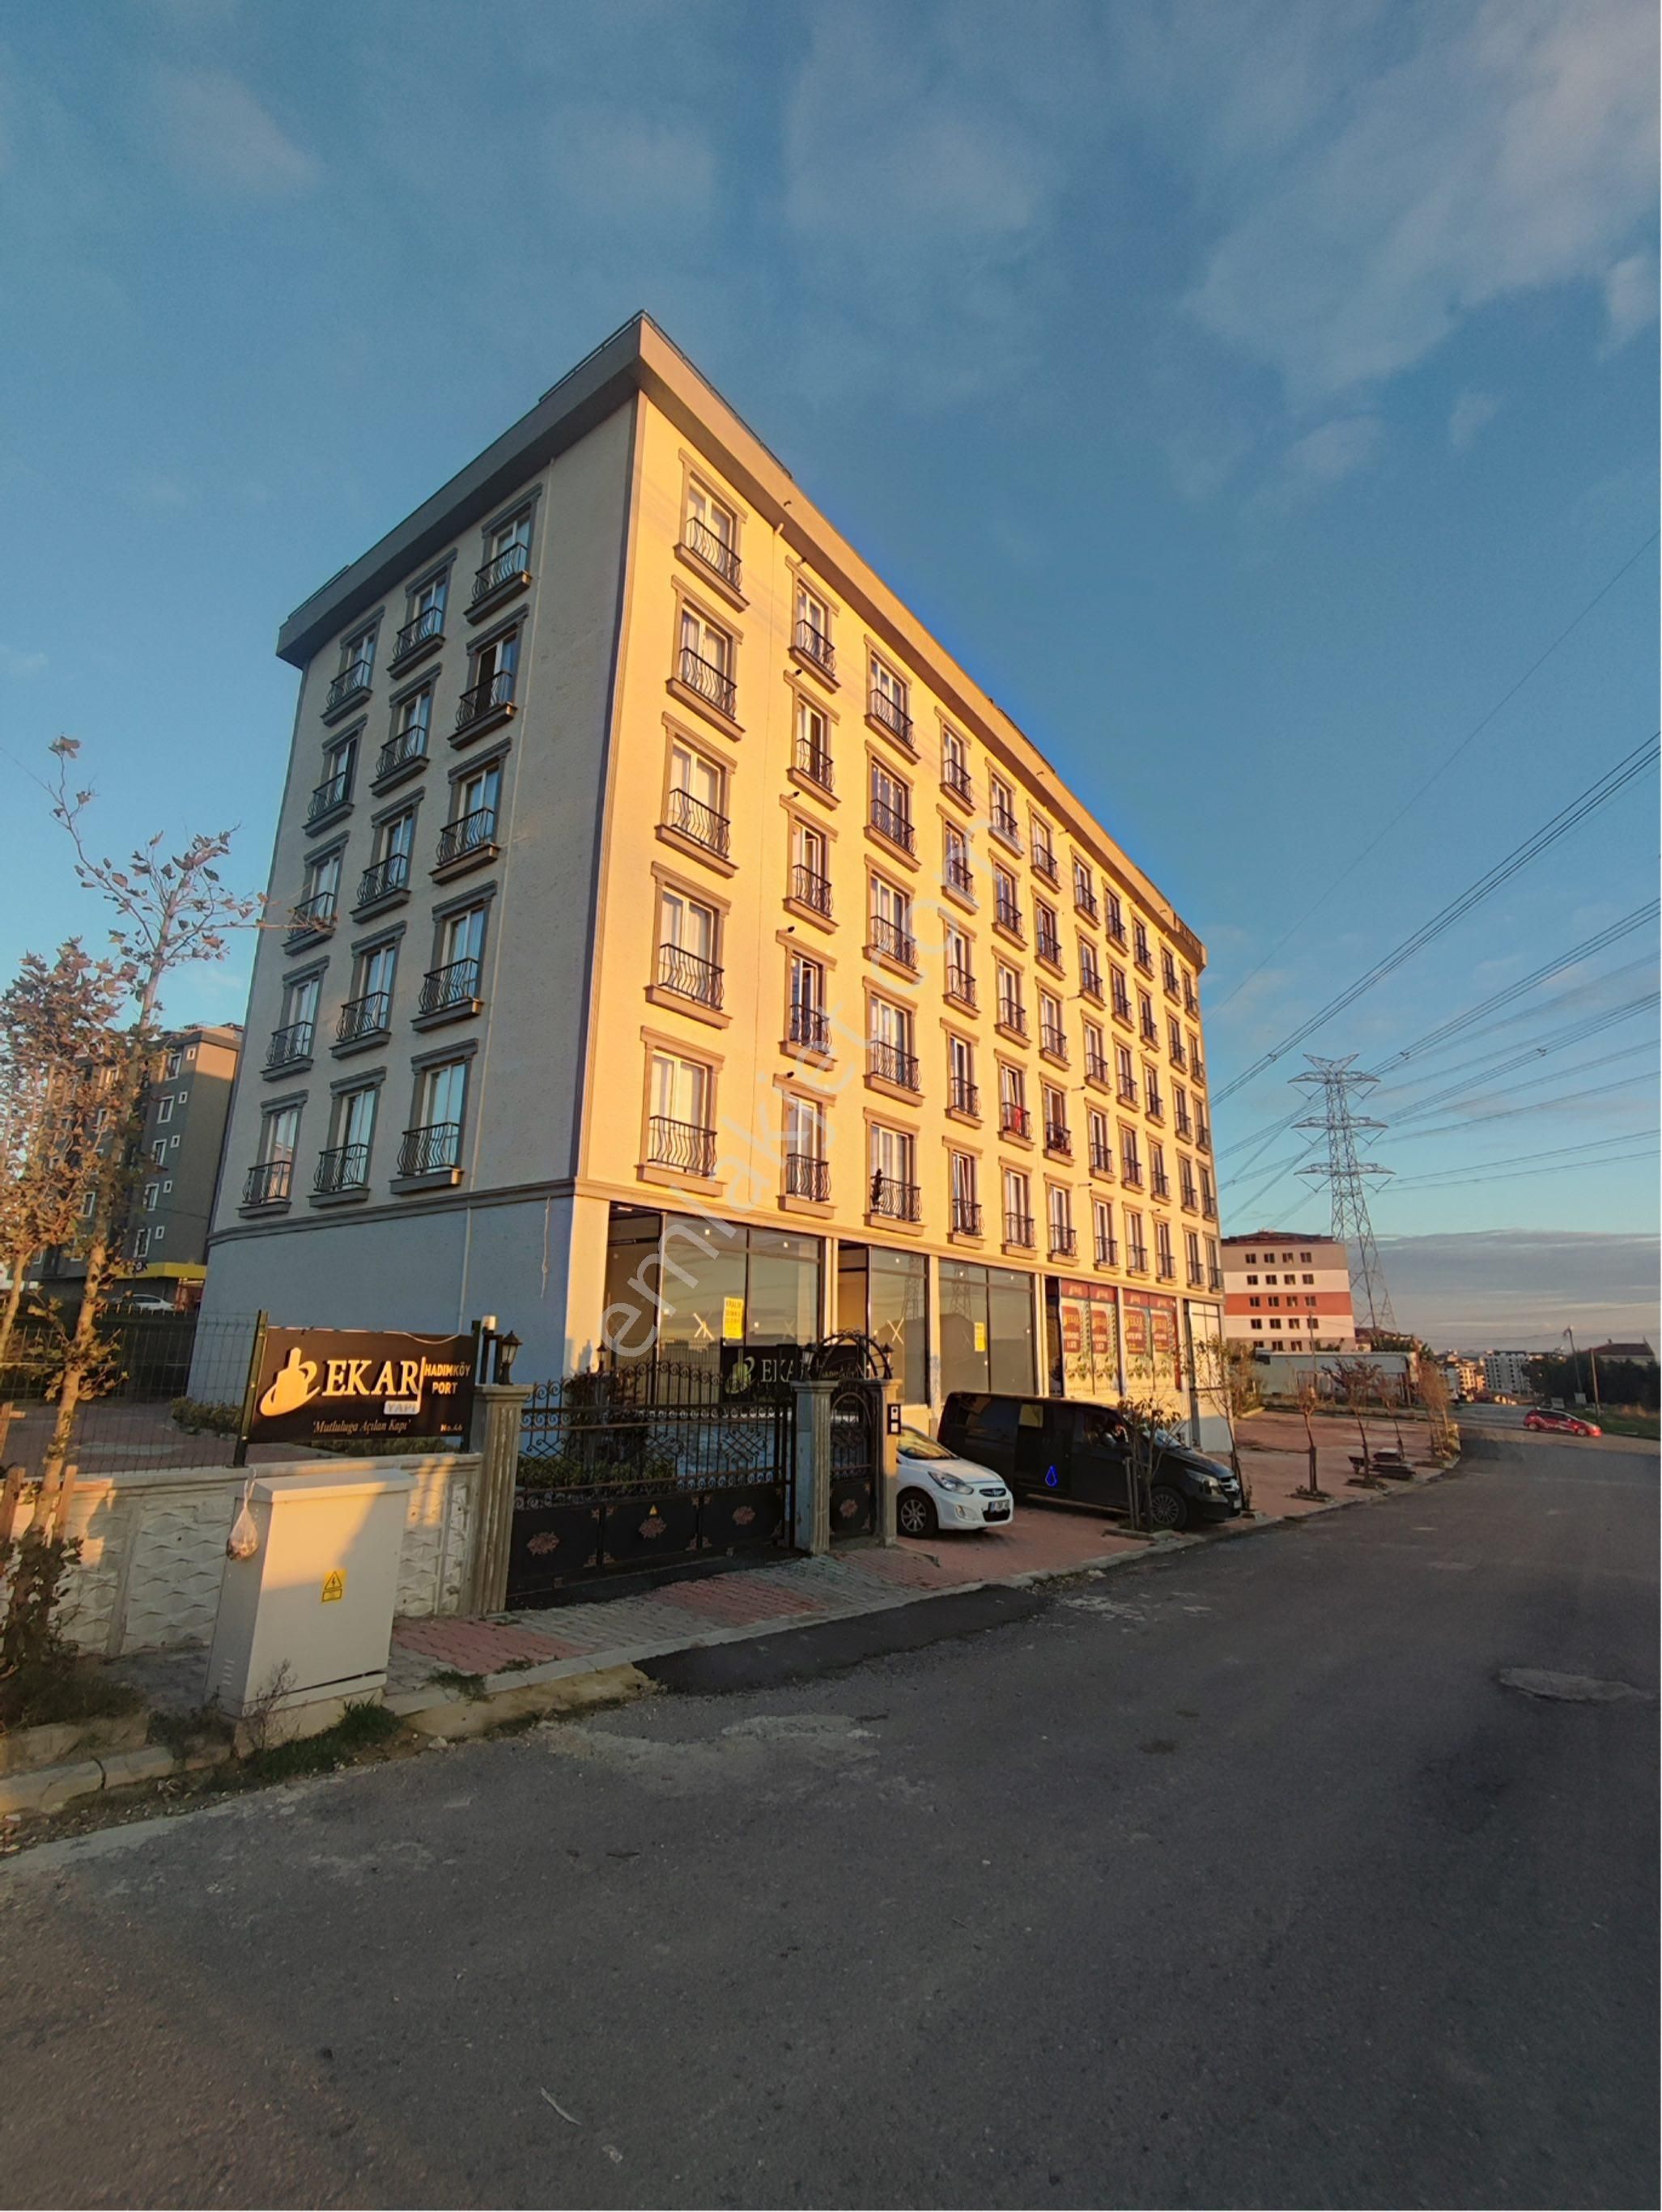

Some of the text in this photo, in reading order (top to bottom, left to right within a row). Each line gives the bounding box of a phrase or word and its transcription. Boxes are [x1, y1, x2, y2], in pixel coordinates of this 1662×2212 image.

[321, 1360, 419, 1396] EKAR
[431, 1381, 458, 1395] PORT
[388, 1403, 416, 1412] YAPI
